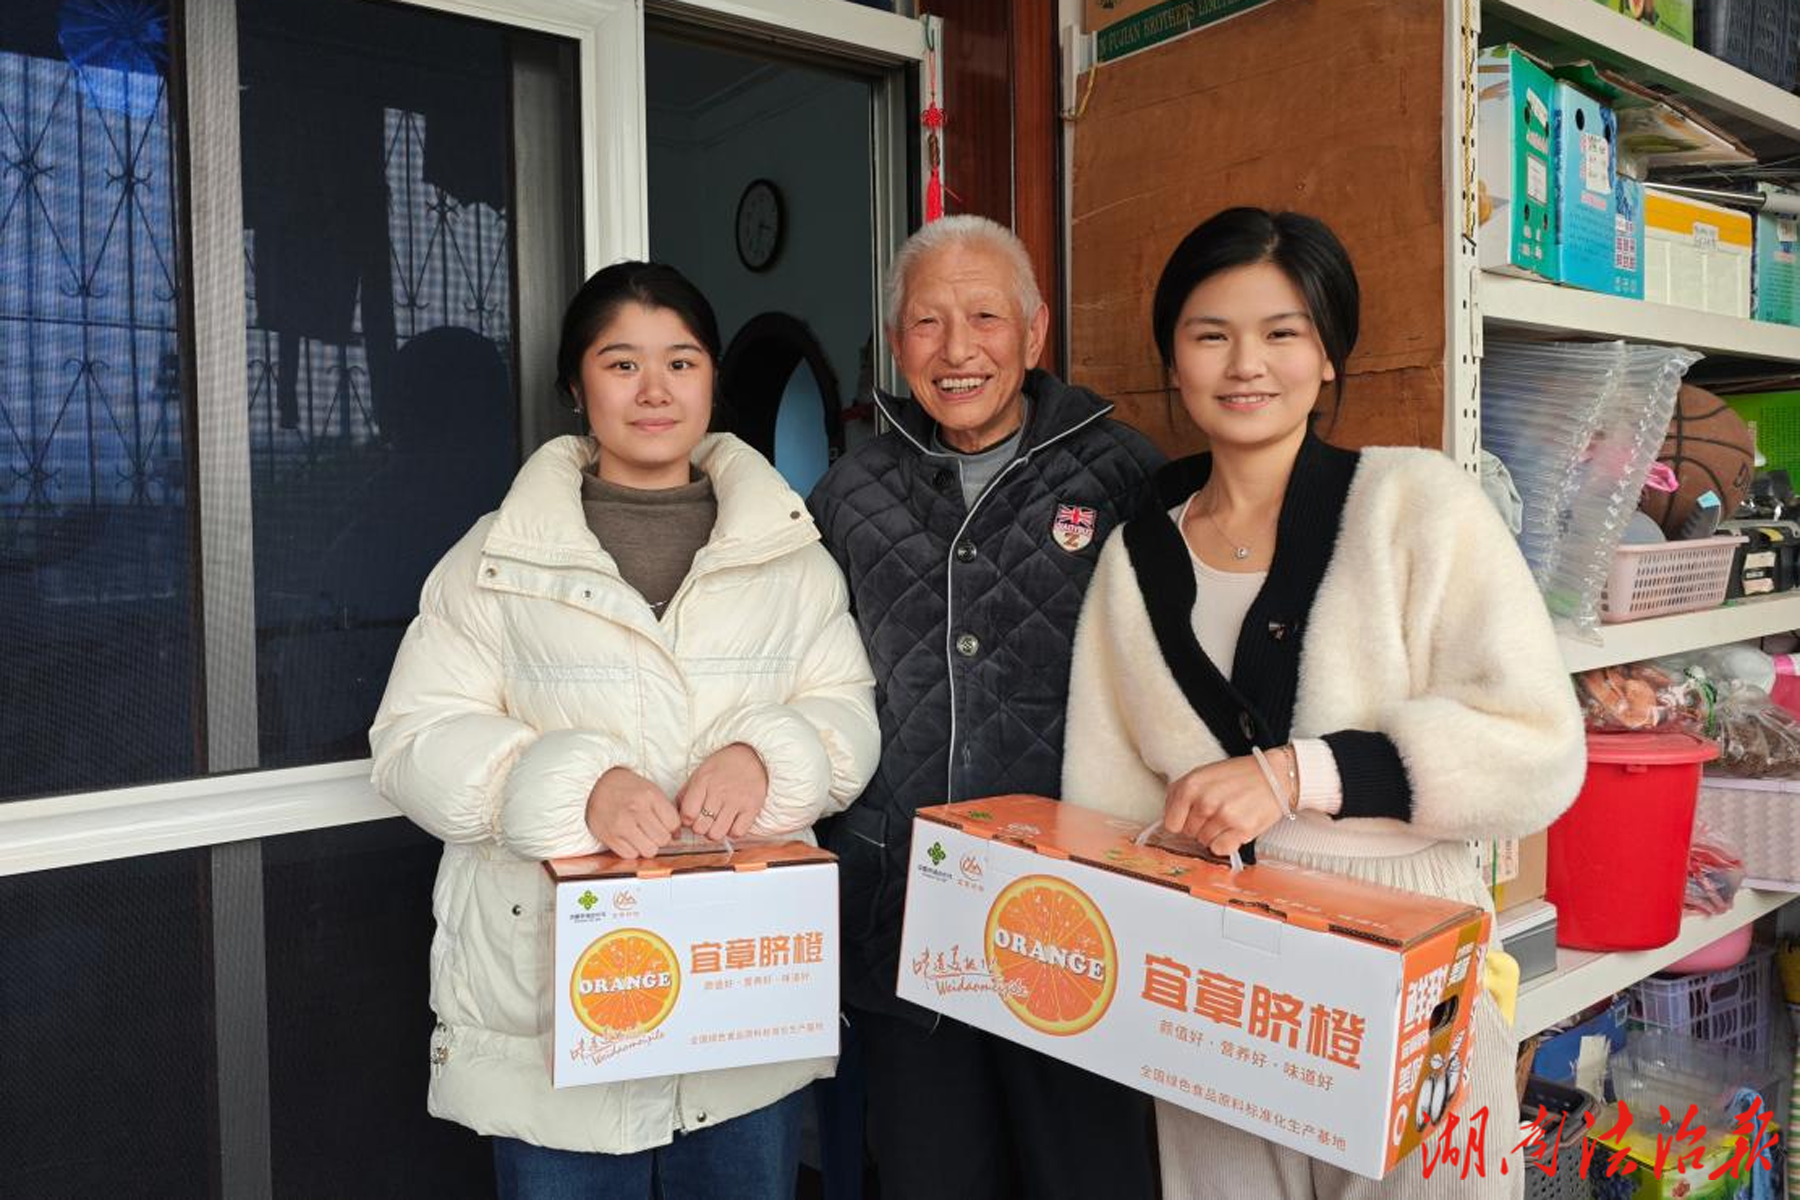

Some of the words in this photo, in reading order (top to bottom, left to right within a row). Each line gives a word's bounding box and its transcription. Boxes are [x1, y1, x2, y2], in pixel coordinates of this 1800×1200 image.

[691, 931, 823, 974] 宜章脐橙
[994, 927, 1106, 982] ORANGE
[579, 972, 672, 994] ORANGE
[1139, 953, 1366, 1070] 宜章脐橙
[1140, 1064, 1347, 1151] 全国绿色食品原料标准化生产基地
